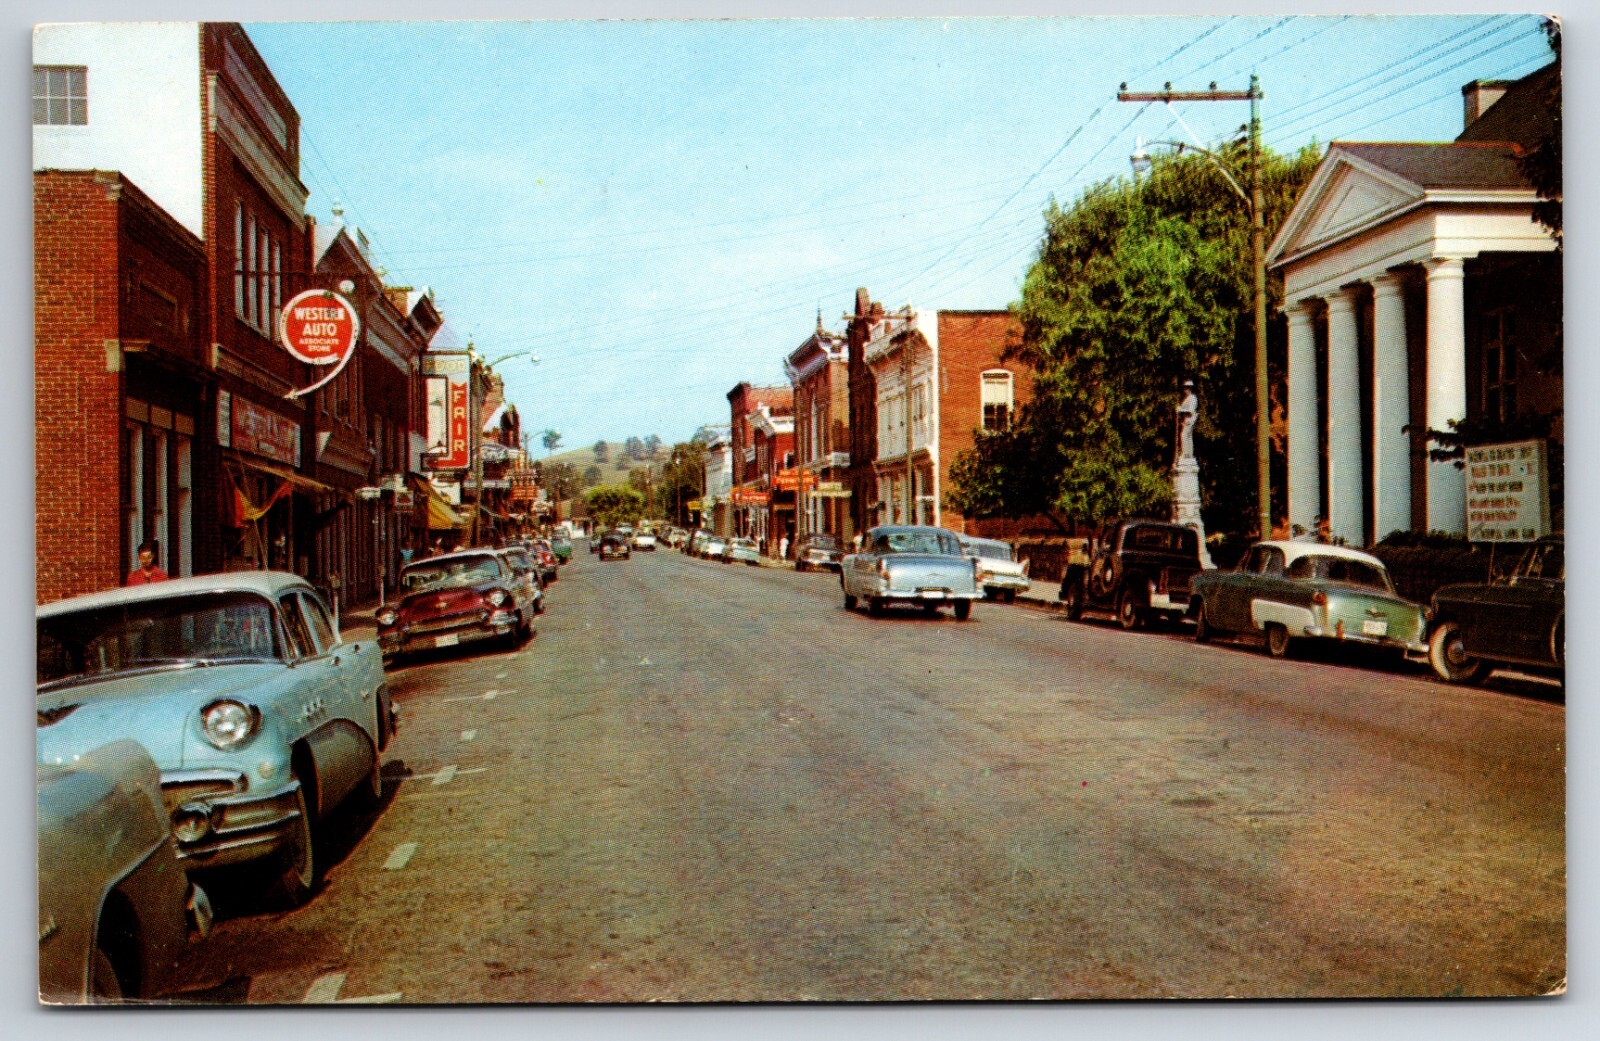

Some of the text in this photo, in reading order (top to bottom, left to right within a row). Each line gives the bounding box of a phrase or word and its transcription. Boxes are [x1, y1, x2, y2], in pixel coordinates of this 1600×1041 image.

[294, 307, 345, 321] WESTERN
[303, 323, 337, 336] AUTO
[453, 390, 465, 452] FAIR
